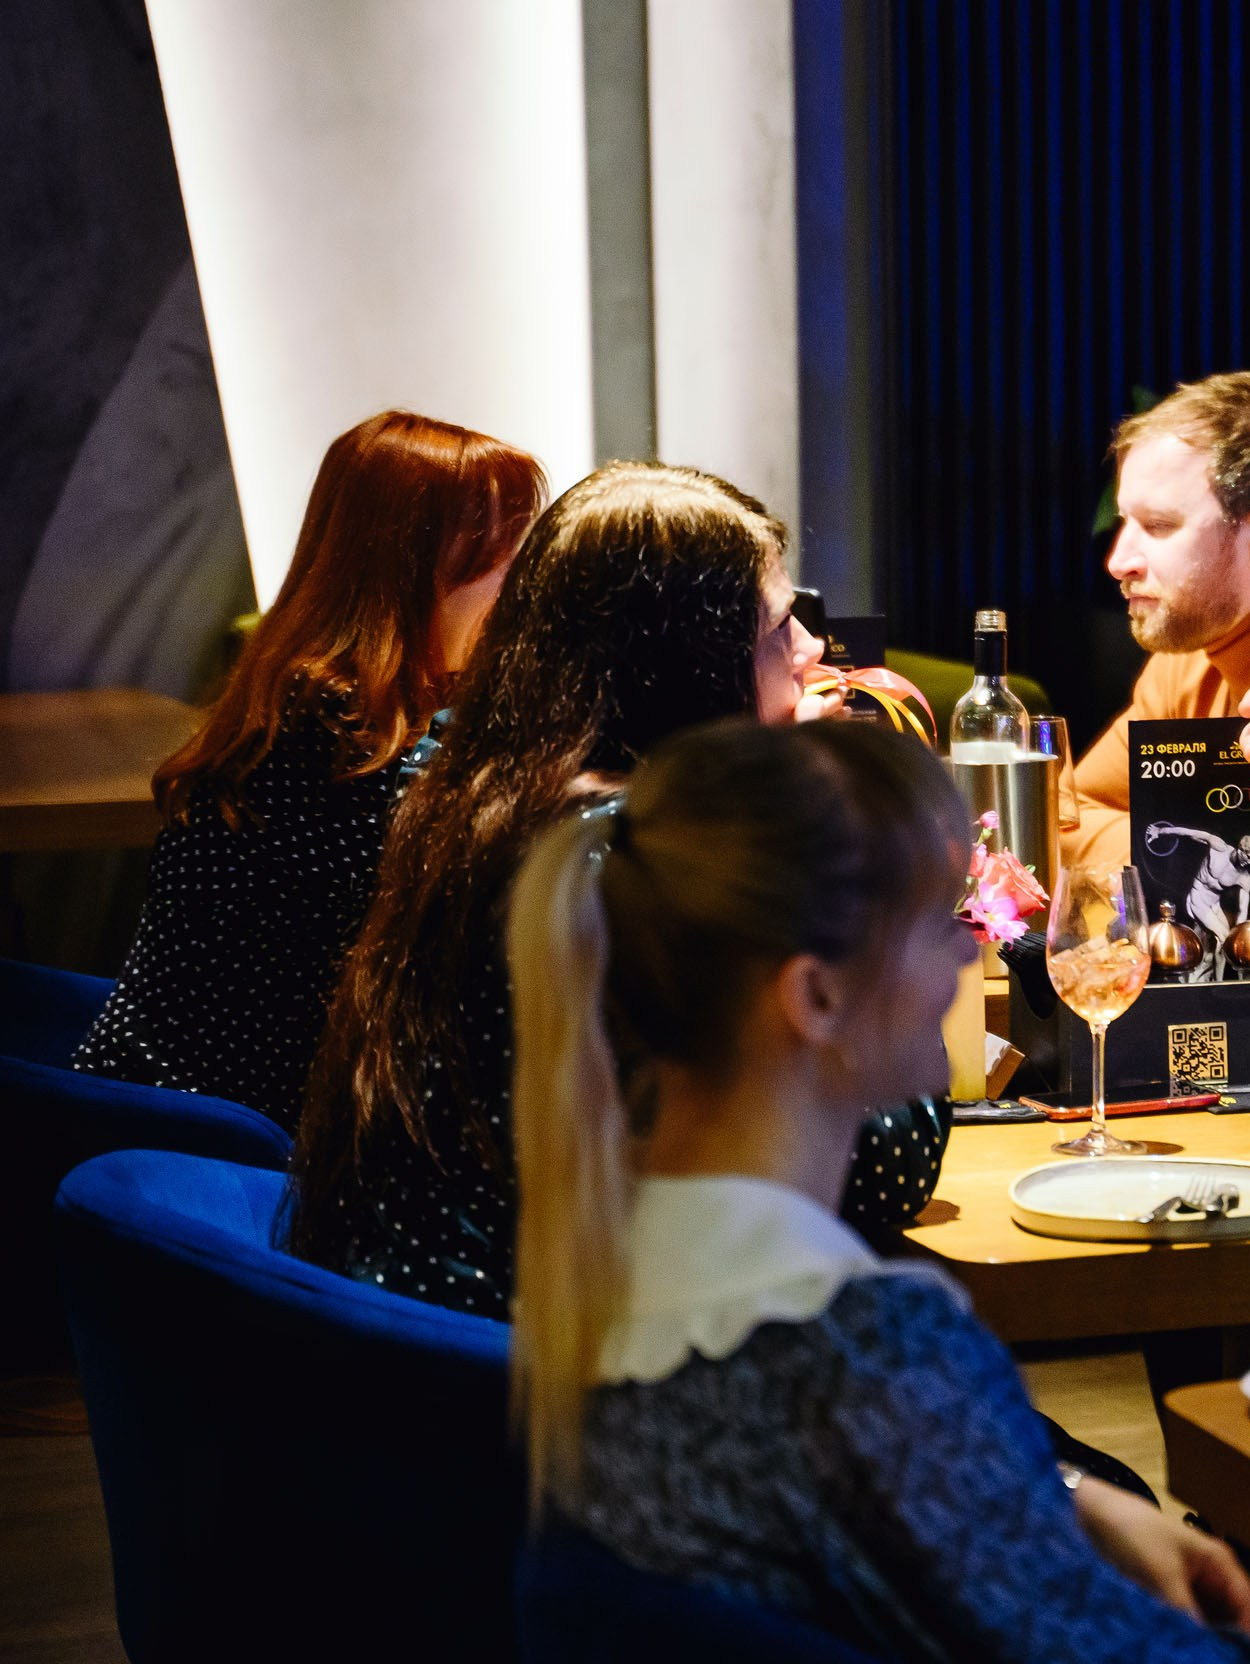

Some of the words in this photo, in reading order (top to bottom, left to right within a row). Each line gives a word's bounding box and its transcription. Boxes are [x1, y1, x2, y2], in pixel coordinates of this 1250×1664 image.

[1140, 744, 1154, 755] 23
[1156, 743, 1206, 754] ФЕВРАЛЯ
[1141, 760, 1195, 778] 20:00
